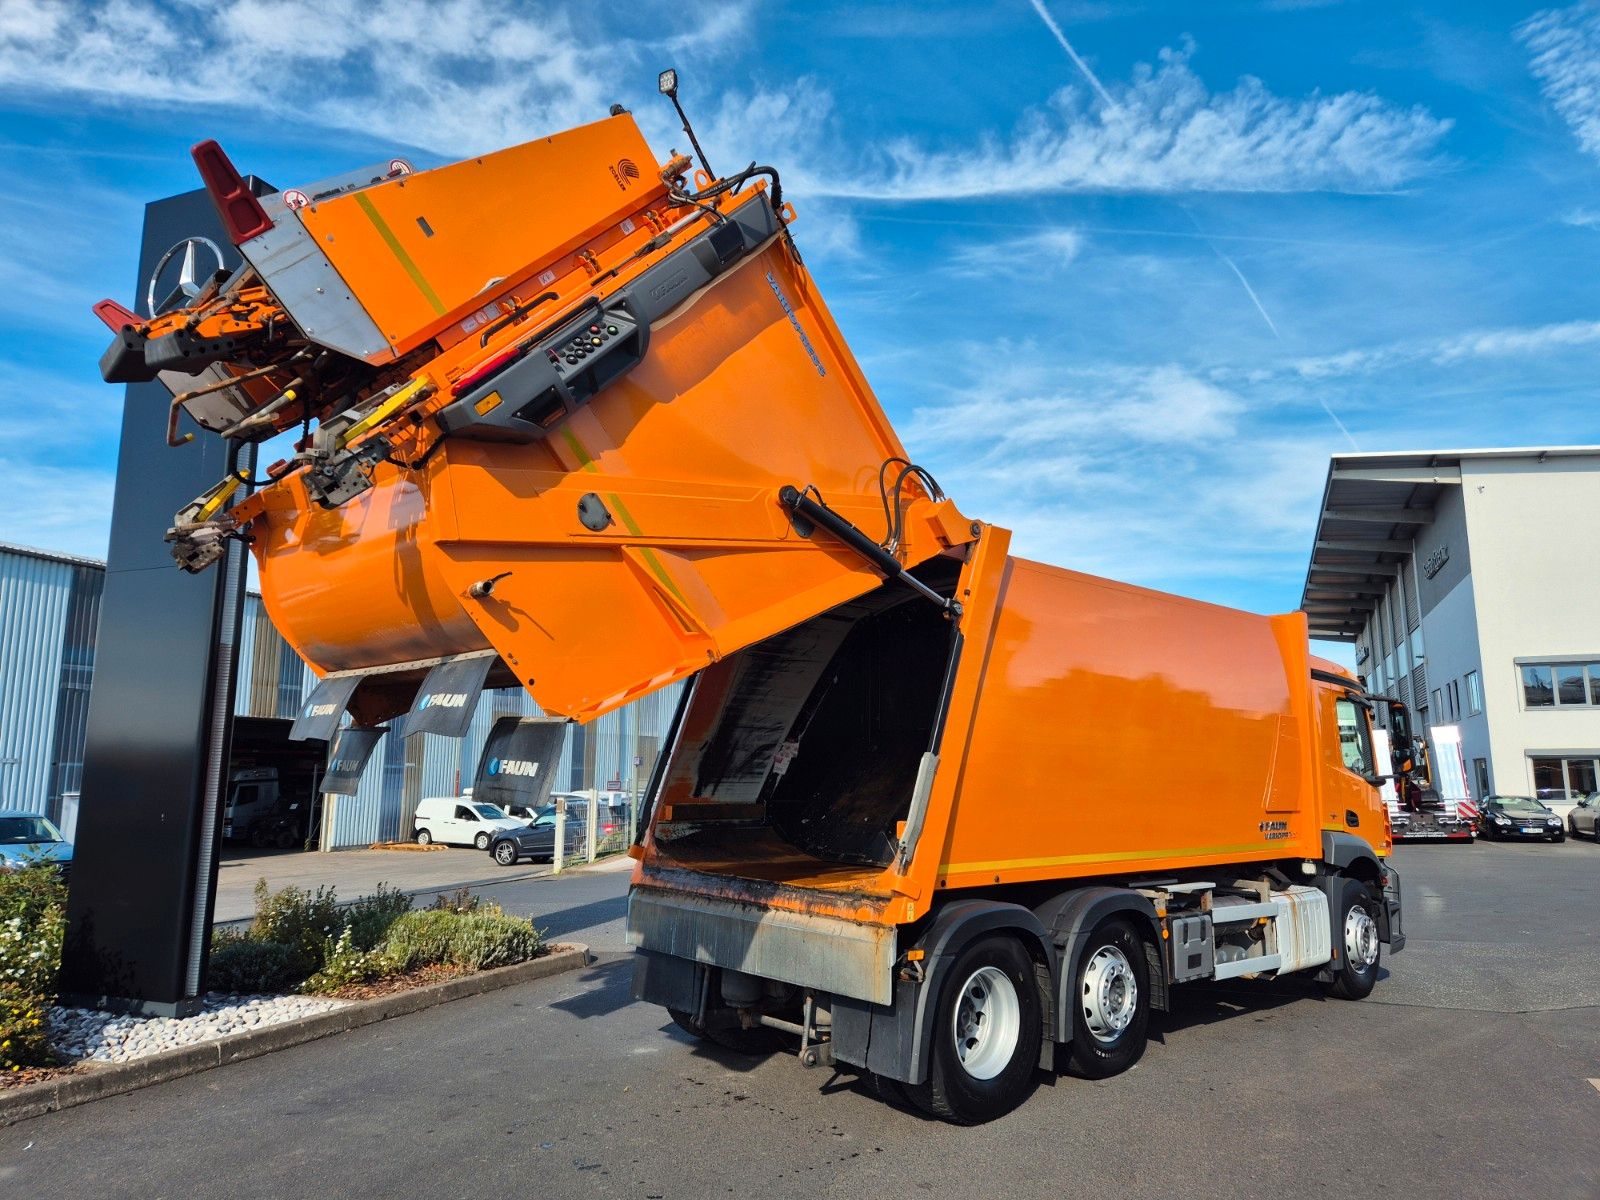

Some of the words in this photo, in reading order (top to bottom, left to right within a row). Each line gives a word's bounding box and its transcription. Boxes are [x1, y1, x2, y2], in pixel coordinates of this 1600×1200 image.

[427, 693, 468, 708] FAUN
[311, 704, 337, 717] FAUN
[336, 760, 360, 772] FAUN
[498, 759, 539, 777] FAUN
[1265, 821, 1288, 831] FAUN
